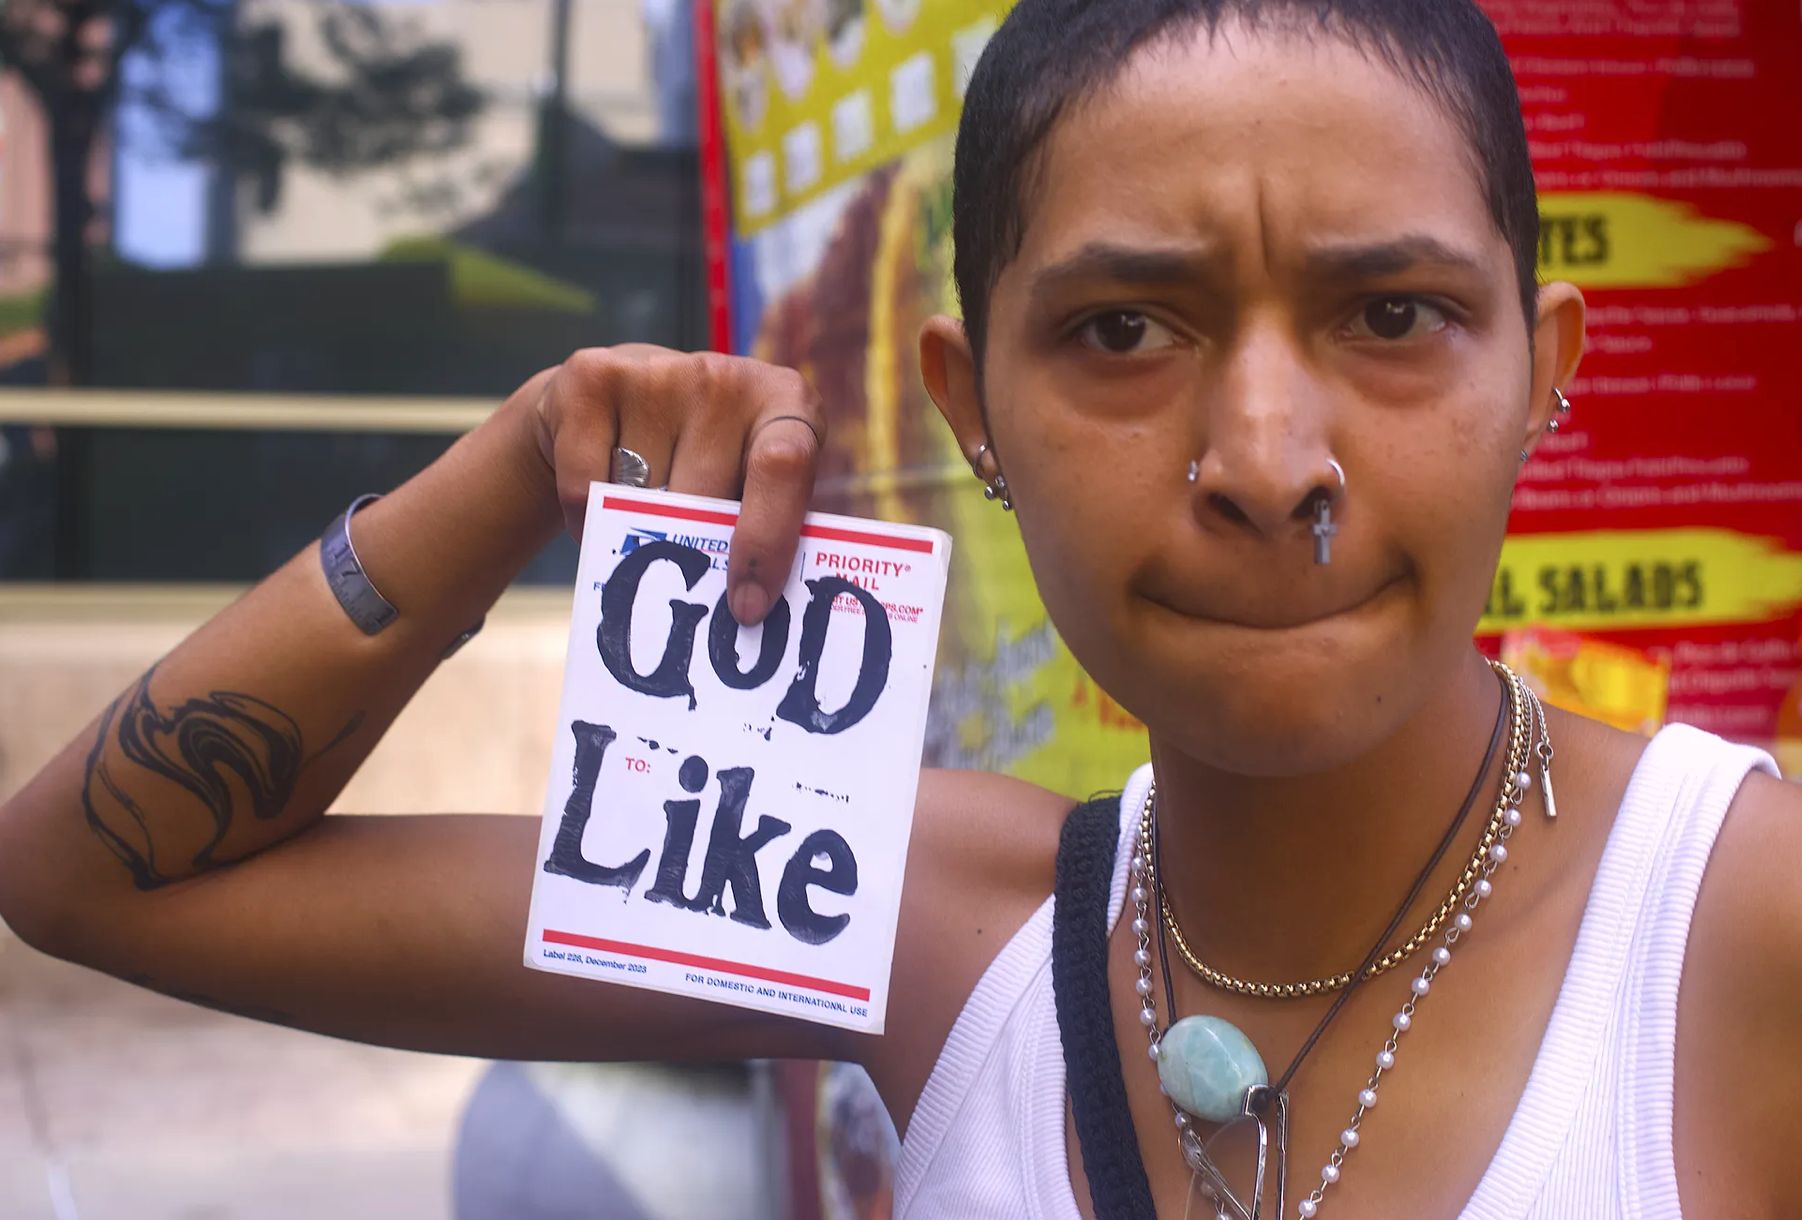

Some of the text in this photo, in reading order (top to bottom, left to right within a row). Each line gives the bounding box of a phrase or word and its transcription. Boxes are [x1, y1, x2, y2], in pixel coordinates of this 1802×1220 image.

[1539, 214, 1608, 266] TES
[672, 534, 729, 552] UNITED
[1538, 560, 1705, 615] SALADS
[625, 757, 651, 774] TO:
[543, 721, 859, 945] Like
[543, 949, 566, 960] Label
[586, 956, 627, 970] December
[685, 973, 868, 1017] FOR DOMESTIC AND INTERNATIONAL USE
